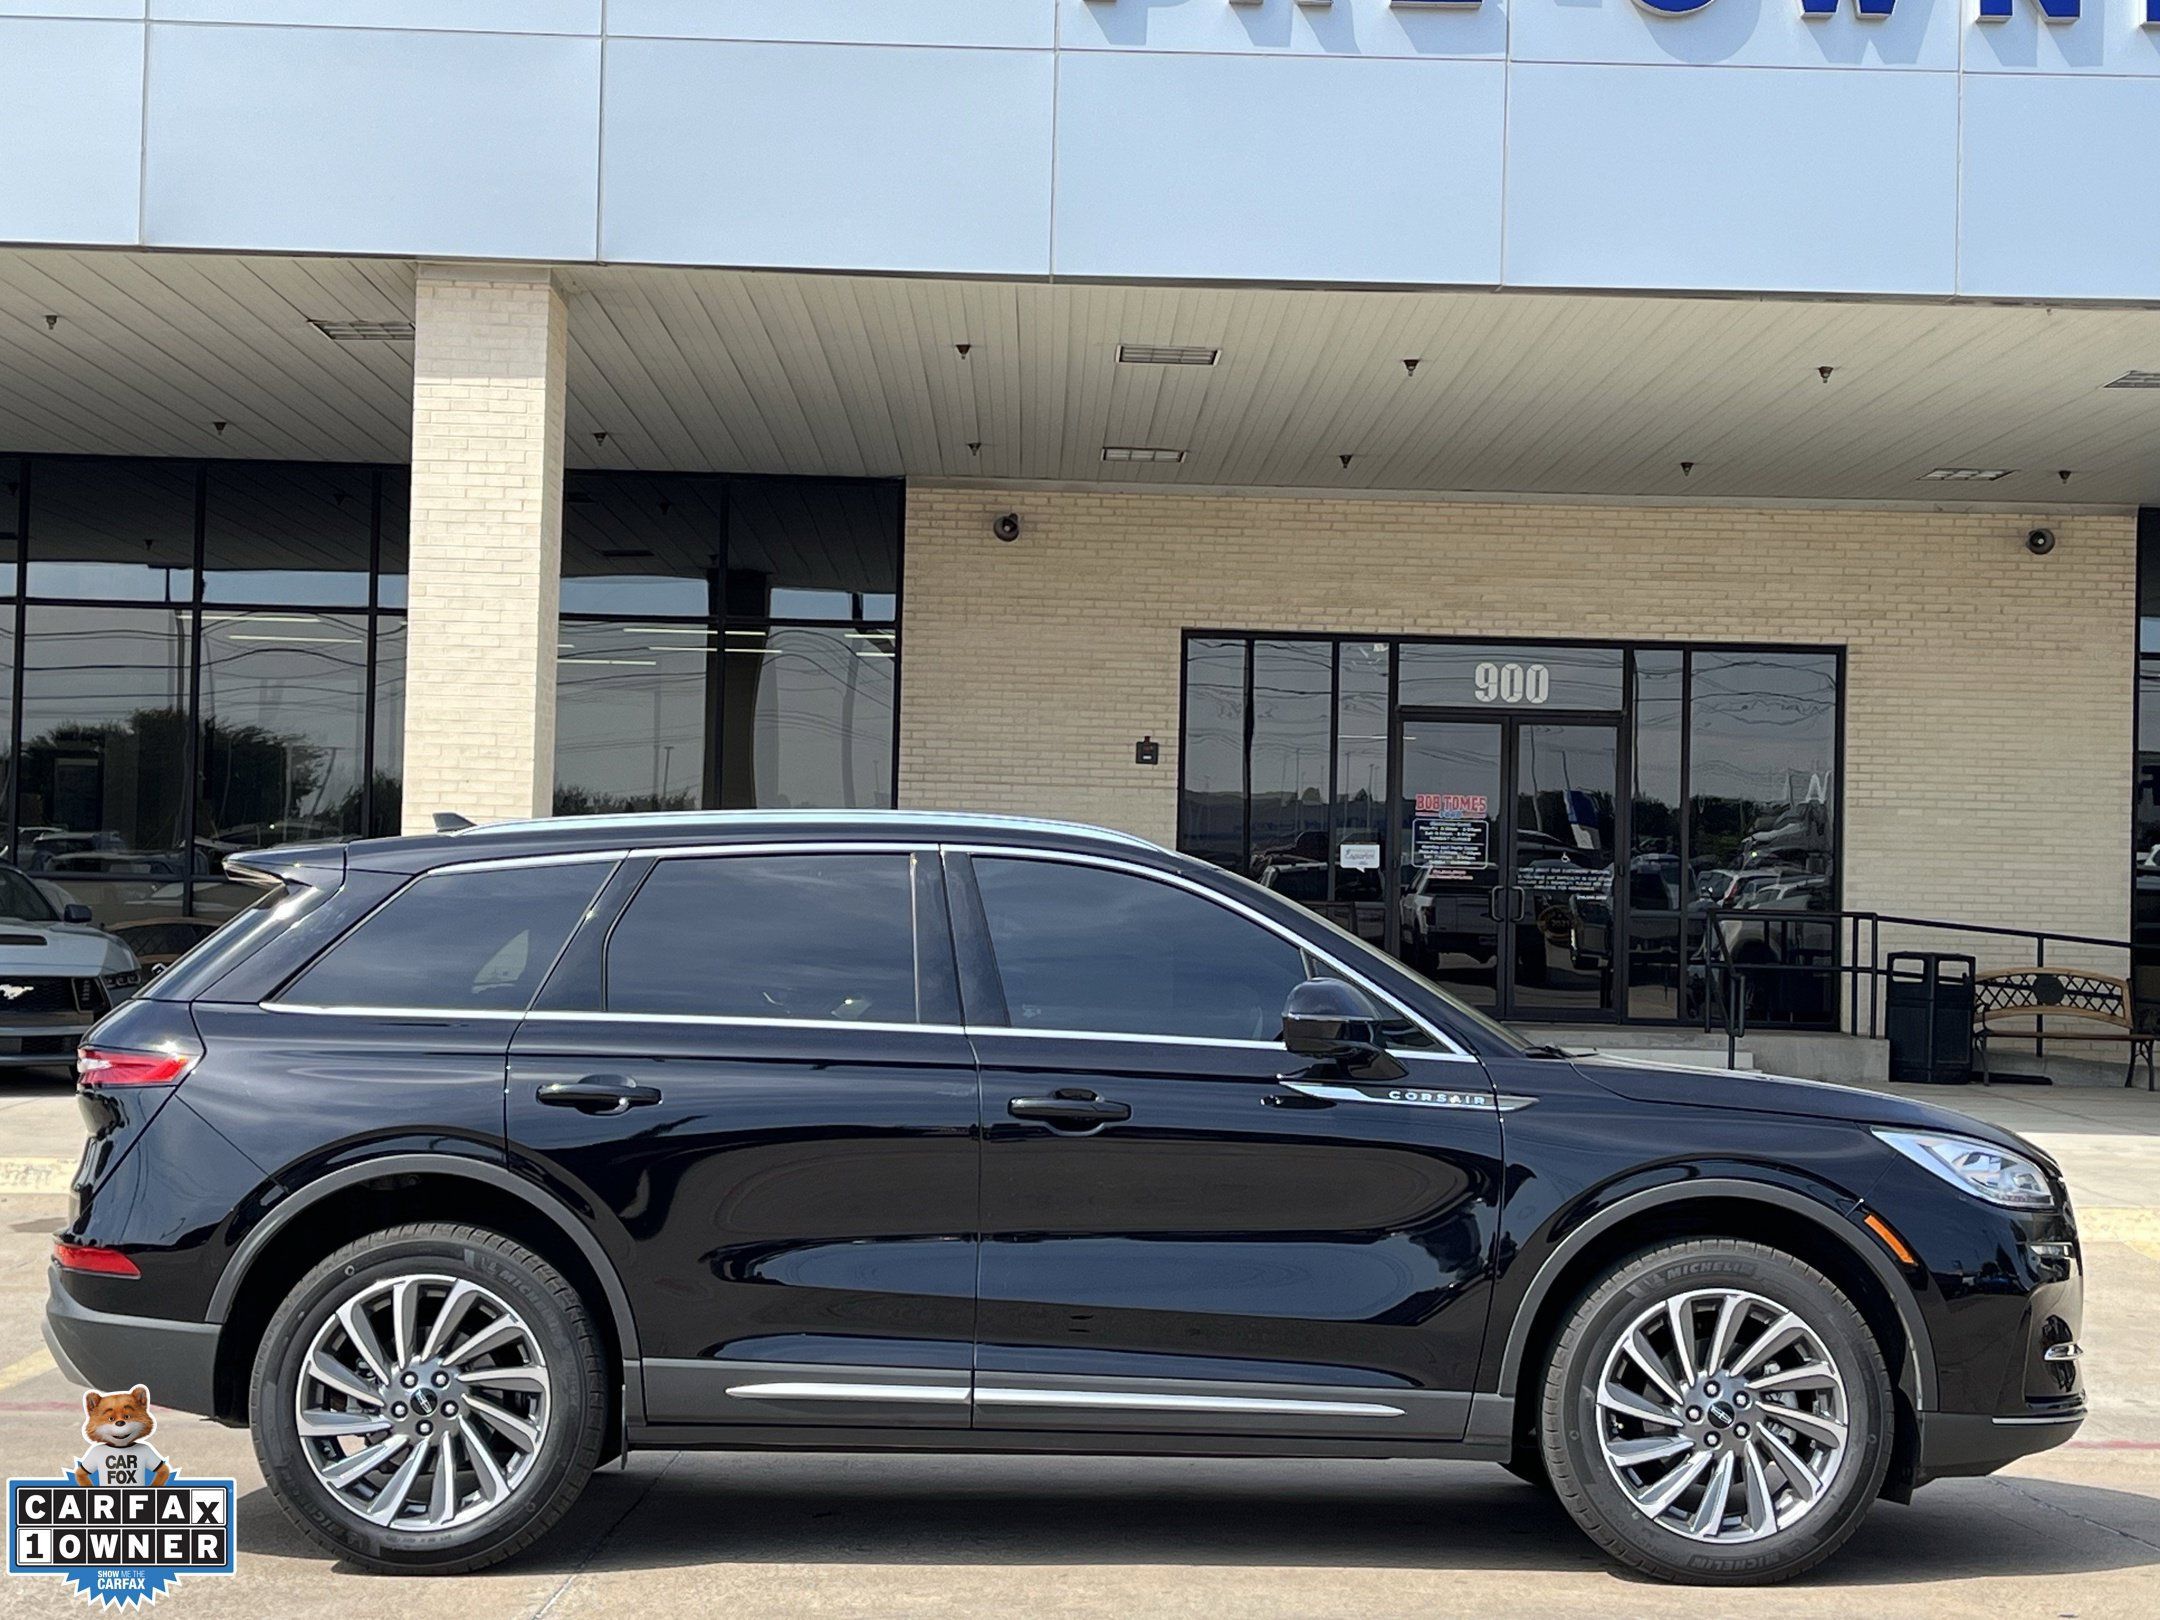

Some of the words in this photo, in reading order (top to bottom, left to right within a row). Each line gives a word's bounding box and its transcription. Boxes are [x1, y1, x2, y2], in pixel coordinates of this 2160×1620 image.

[1475, 662, 1549, 704] 900
[1415, 794, 1440, 811] BOB
[1442, 795, 1487, 812] TOMES
[1388, 1090, 1485, 1105] CORSAIR
[1667, 1261, 1754, 1279] MICHELIN
